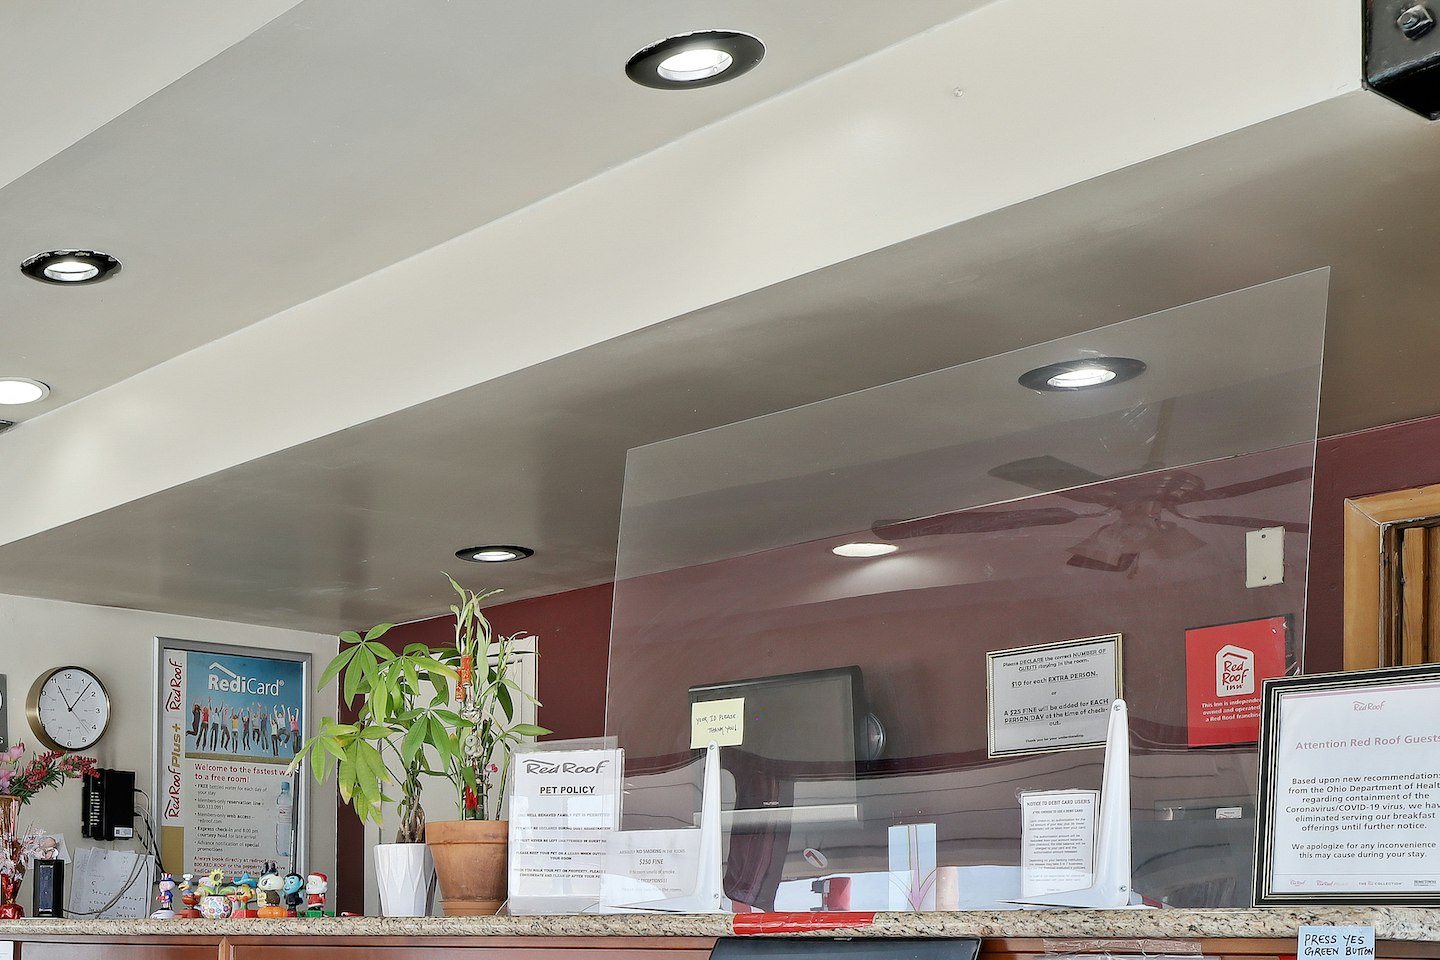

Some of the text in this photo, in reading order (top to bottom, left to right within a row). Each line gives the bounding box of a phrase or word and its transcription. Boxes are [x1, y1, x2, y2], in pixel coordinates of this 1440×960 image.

[1224, 661, 1244, 672] Red
[1223, 669, 1249, 685] Roof
[1296, 740, 1346, 750] Attention
[1350, 738, 1370, 746] Red
[1375, 736, 1401, 745] Roof
[194, 763, 227, 773] Welcome
[229, 765, 238, 773] to
[240, 765, 251, 774] the
[254, 767, 277, 776] fastest
[526, 760, 610, 774] Red Roof
[560, 786, 595, 794] POLICY
[1350, 784, 1402, 792] Department
[1302, 796, 1342, 804] regarding
[1346, 794, 1400, 802] containment
[1286, 804, 1380, 813] Coronavirus/COVID-19
[1296, 814, 1339, 822] eliminated
[1342, 814, 1373, 822] serving
[1393, 812, 1435, 820] breakfast
[1306, 843, 1344, 851] apologize
[1305, 934, 1364, 946] PRESS YES
[1305, 947, 1373, 956] GREEN BUTTON
